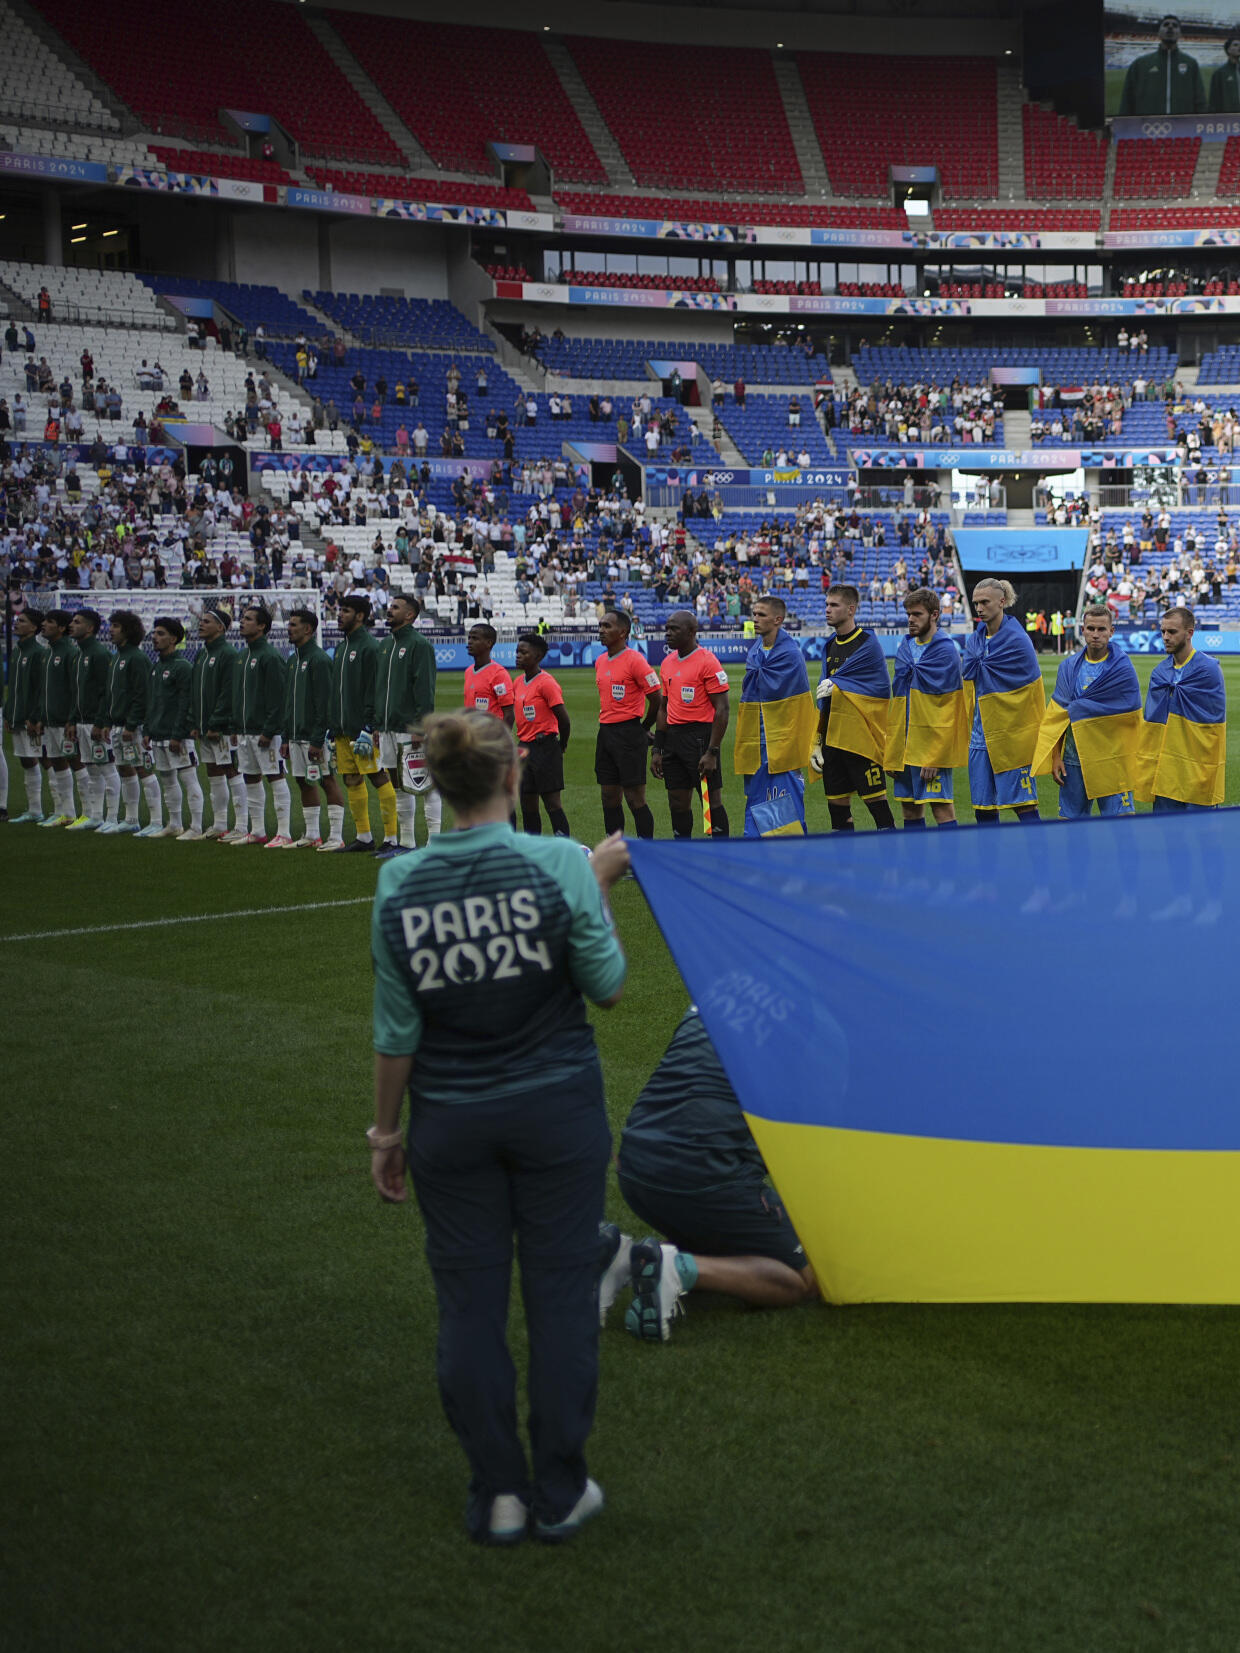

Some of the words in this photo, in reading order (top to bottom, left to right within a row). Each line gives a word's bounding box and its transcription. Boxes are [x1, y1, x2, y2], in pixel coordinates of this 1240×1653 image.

[1196, 123, 1240, 134] PARIS
[5, 156, 44, 169] PARIS
[50, 162, 85, 176] 2024
[296, 192, 329, 204] PARIS
[333, 195, 363, 208] 2024
[576, 221, 609, 230] PARIS
[615, 222, 645, 232] 2024
[585, 291, 619, 302] PARIS
[623, 292, 654, 303] 2024
[797, 299, 830, 309] PARIS
[834, 300, 864, 310] 2024
[1057, 301, 1090, 312] PARIS
[1093, 301, 1123, 311] 2024
[990, 455, 1027, 465] PARIS
[1033, 455, 1066, 465] 2024
[421, 464, 453, 475] ARIS
[807, 473, 842, 485] 2024
[728, 645, 748, 653] 2024
[865, 767, 882, 786] 12
[1021, 776, 1032, 795] 4
[410, 934, 553, 992] 2024
